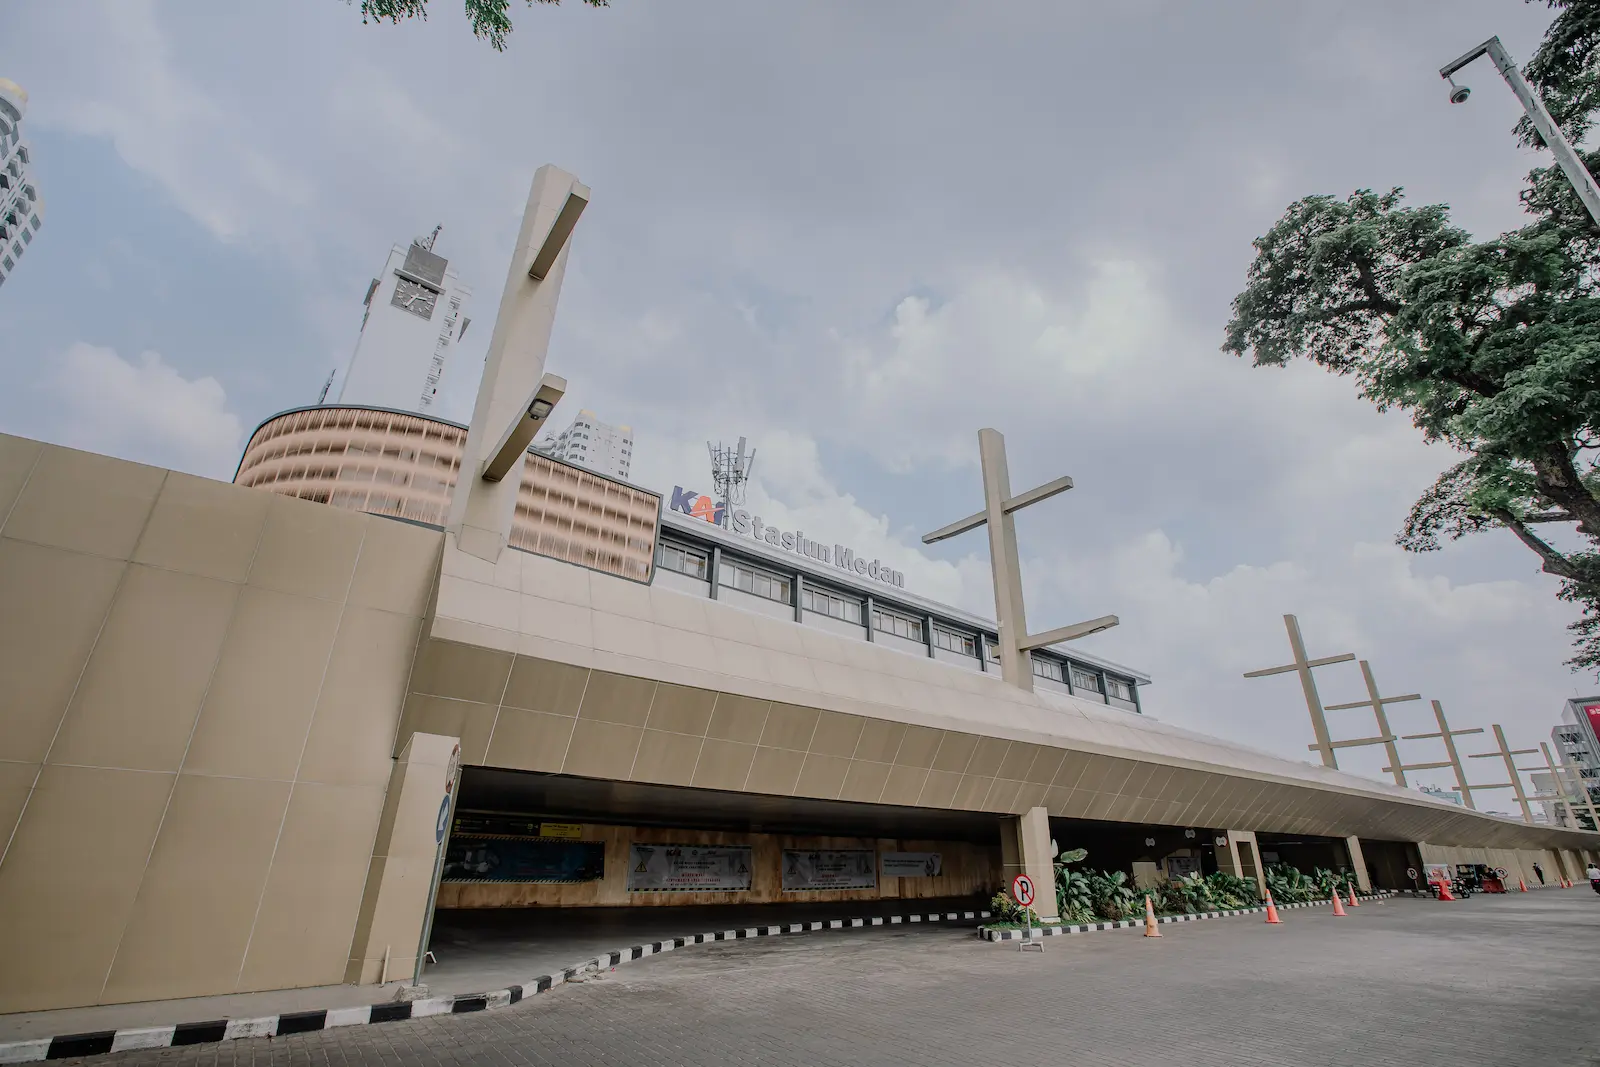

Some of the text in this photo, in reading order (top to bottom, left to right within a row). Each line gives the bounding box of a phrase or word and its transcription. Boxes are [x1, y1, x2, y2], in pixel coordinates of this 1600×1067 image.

[670, 485, 725, 526] KAI
[732, 509, 904, 588] Stasiun Medan
[1020, 880, 1029, 902] P
